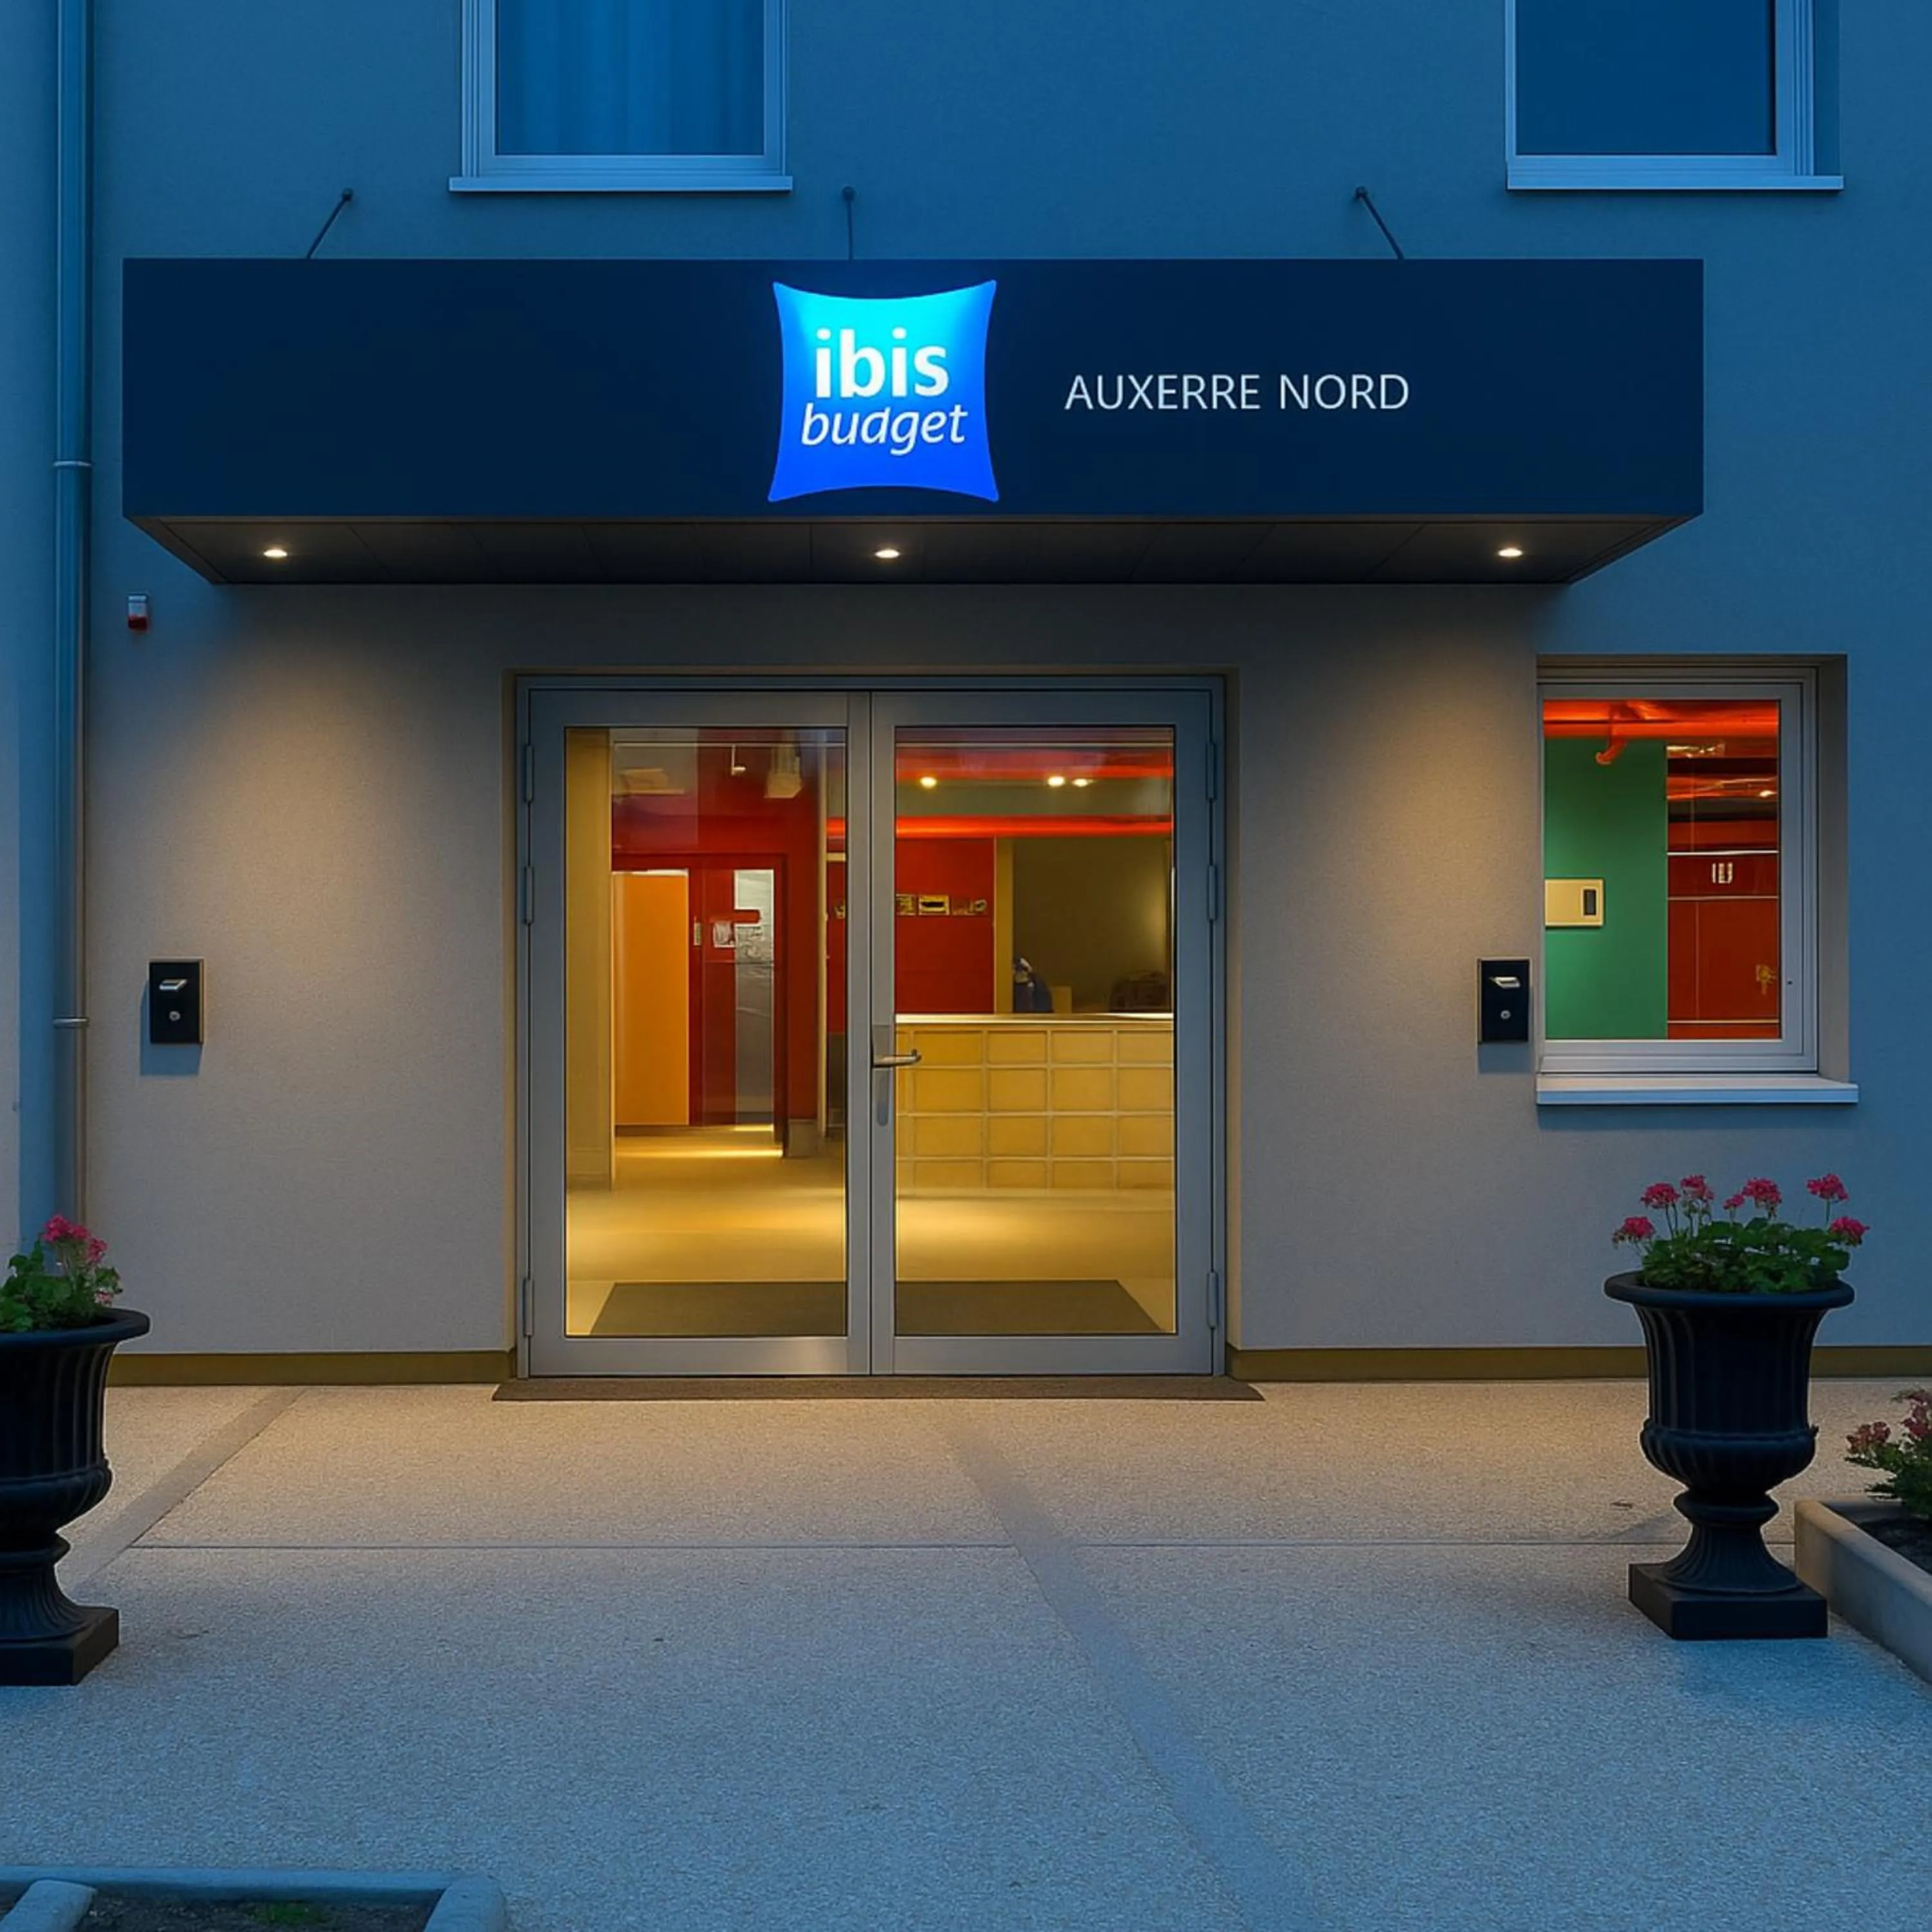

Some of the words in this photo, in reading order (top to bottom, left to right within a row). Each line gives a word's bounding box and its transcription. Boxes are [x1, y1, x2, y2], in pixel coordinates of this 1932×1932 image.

[815, 327, 949, 397] ibis
[1064, 374, 1261, 410] AUXERRE
[1279, 374, 1409, 410] NORD
[800, 402, 967, 455] budget
